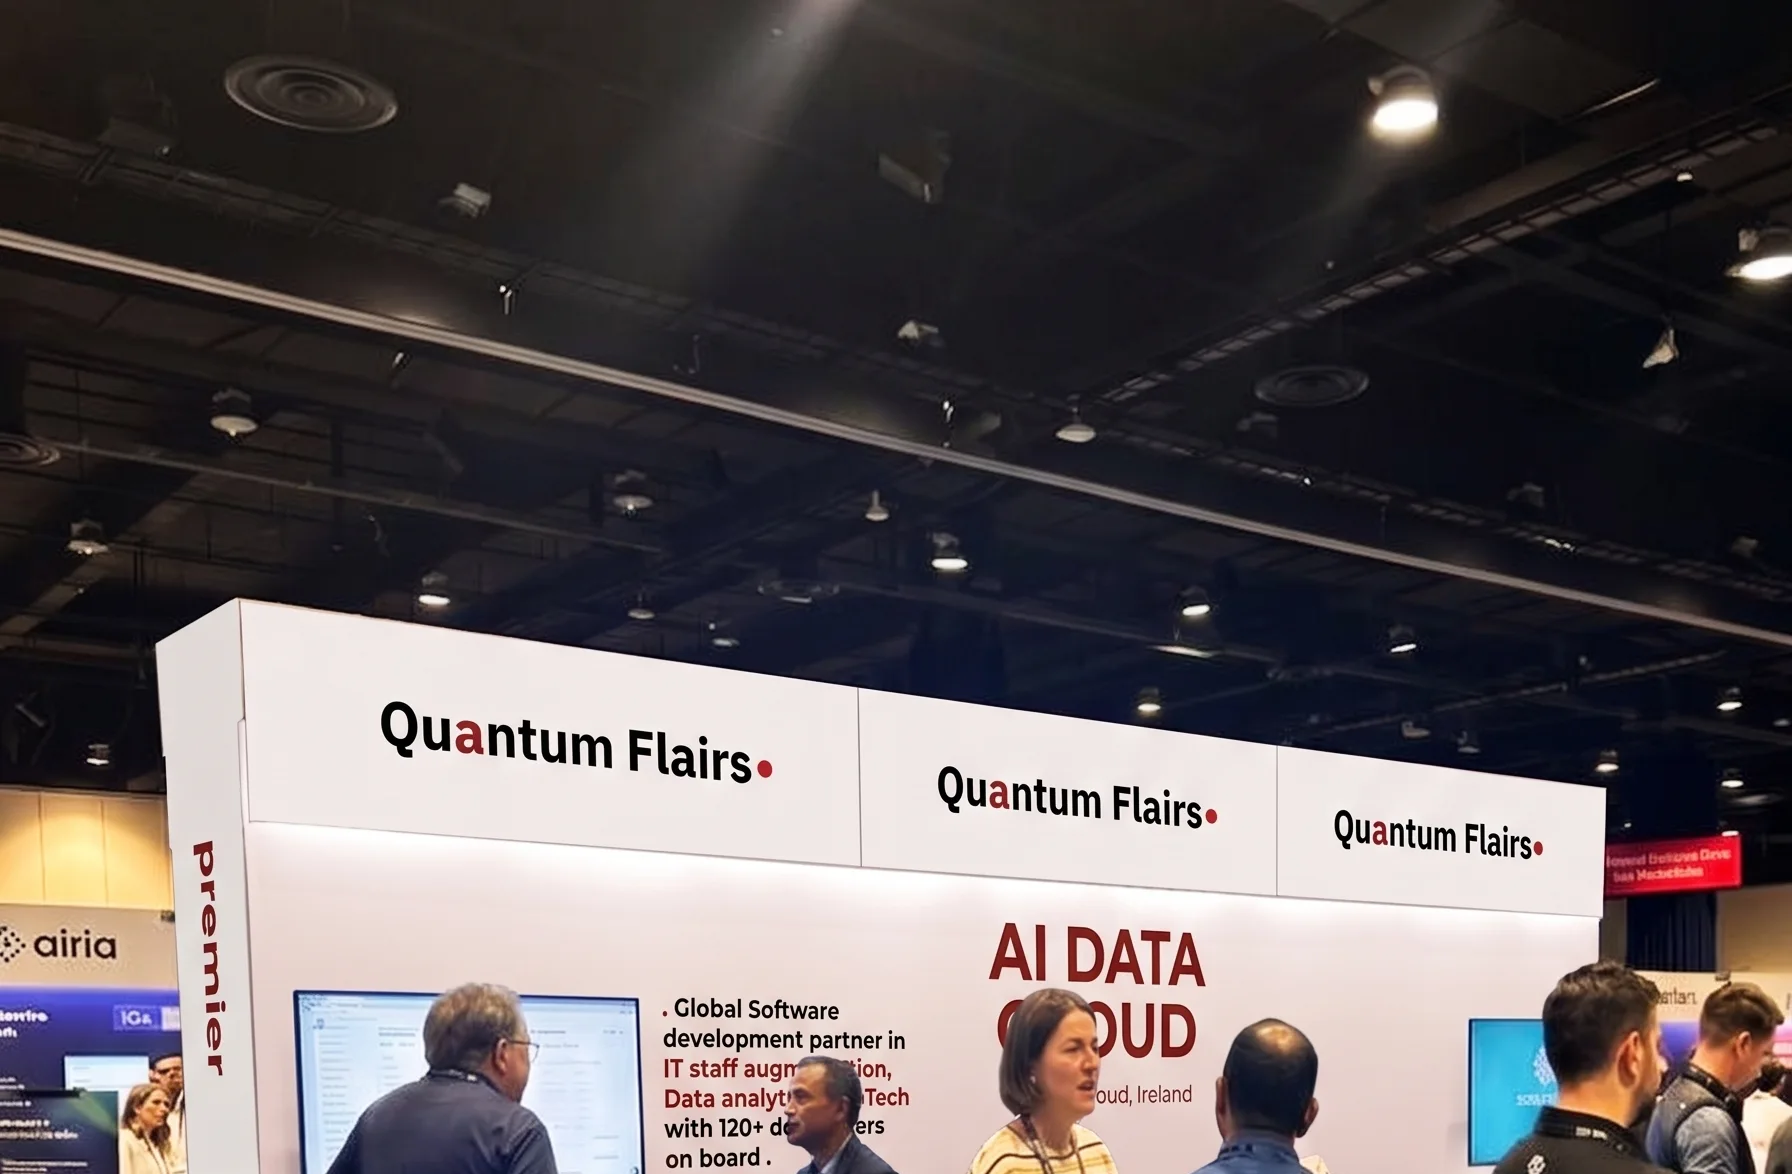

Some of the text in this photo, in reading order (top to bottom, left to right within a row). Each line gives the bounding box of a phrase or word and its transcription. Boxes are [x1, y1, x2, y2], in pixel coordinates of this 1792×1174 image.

[381, 701, 612, 768] Quantum
[937, 765, 1102, 818] Quantum
[1333, 809, 1457, 853] Quantum
[33, 928, 117, 959] airia
[989, 922, 1206, 987] AI DATA
[193, 840, 227, 1076] premier
[674, 998, 742, 1019] Global
[748, 999, 840, 1020] Software
[663, 1028, 906, 1053] development partner in
[664, 1058, 684, 1078] IT
[689, 1057, 739, 1078] staff
[664, 1088, 715, 1108] Data
[1137, 1084, 1192, 1104] Ireland
[664, 1117, 713, 1138] with
[719, 1118, 764, 1137] 120+
[665, 1154, 693, 1169] on
[699, 1146, 761, 1168] board
